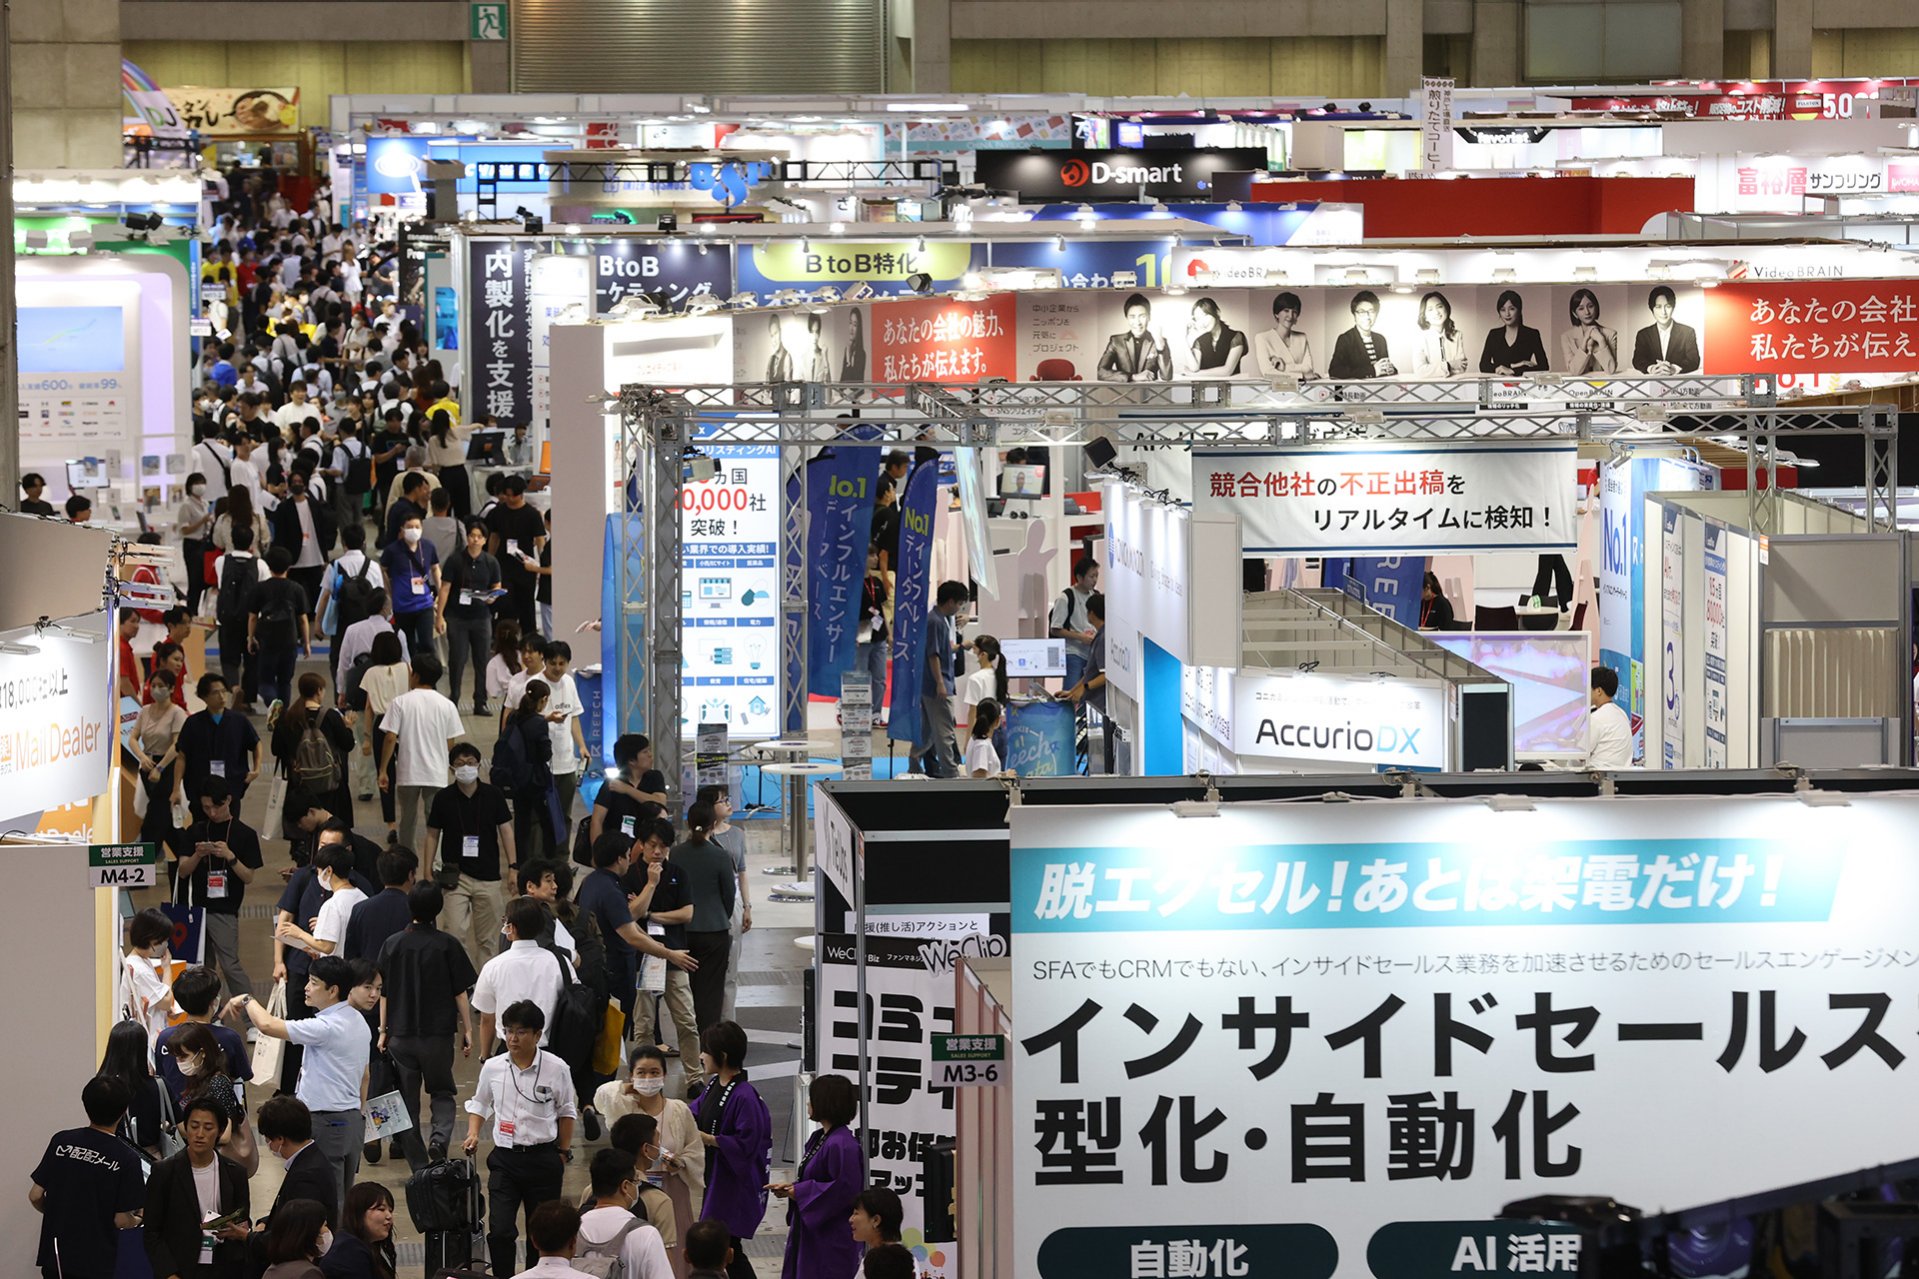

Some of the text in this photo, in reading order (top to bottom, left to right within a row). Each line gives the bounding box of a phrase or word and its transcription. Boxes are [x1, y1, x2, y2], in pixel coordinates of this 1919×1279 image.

[1091, 162, 1183, 184] D-smart
[600, 255, 660, 277] BtoB
[806, 254, 919, 275] BtoB特化
[1754, 266, 1844, 278] VideoBRAIN
[1750, 295, 1918, 326] あなたの会社
[484, 251, 515, 418] 内製化を支援
[1750, 331, 1918, 362] 私たちが伝え
[1210, 469, 1466, 499] 競合他社の不正出稿を
[674, 488, 767, 516] 0,000社
[690, 518, 738, 537] 突破！
[905, 507, 930, 536] No.1
[1314, 505, 1552, 532] リアルタイムに検知！
[1604, 508, 1627, 577] No.1
[826, 503, 858, 664] インフルエンサー
[1256, 718, 1421, 755] AccurioDX
[101, 846, 144, 858] 営業支援
[101, 868, 145, 884] M4-2
[1033, 852, 1786, 920] 脱エクセル！あとは架電だけ！
[946, 1037, 997, 1051] 営業支援
[1020, 990, 1919, 1085] インサイドセールス
[944, 1064, 998, 1083] M3-6
[1034, 1089, 1583, 1186] 型化・自動化
[1130, 1239, 1250, 1279] 自動化
[1451, 1233, 1582, 1272] AI 活用
